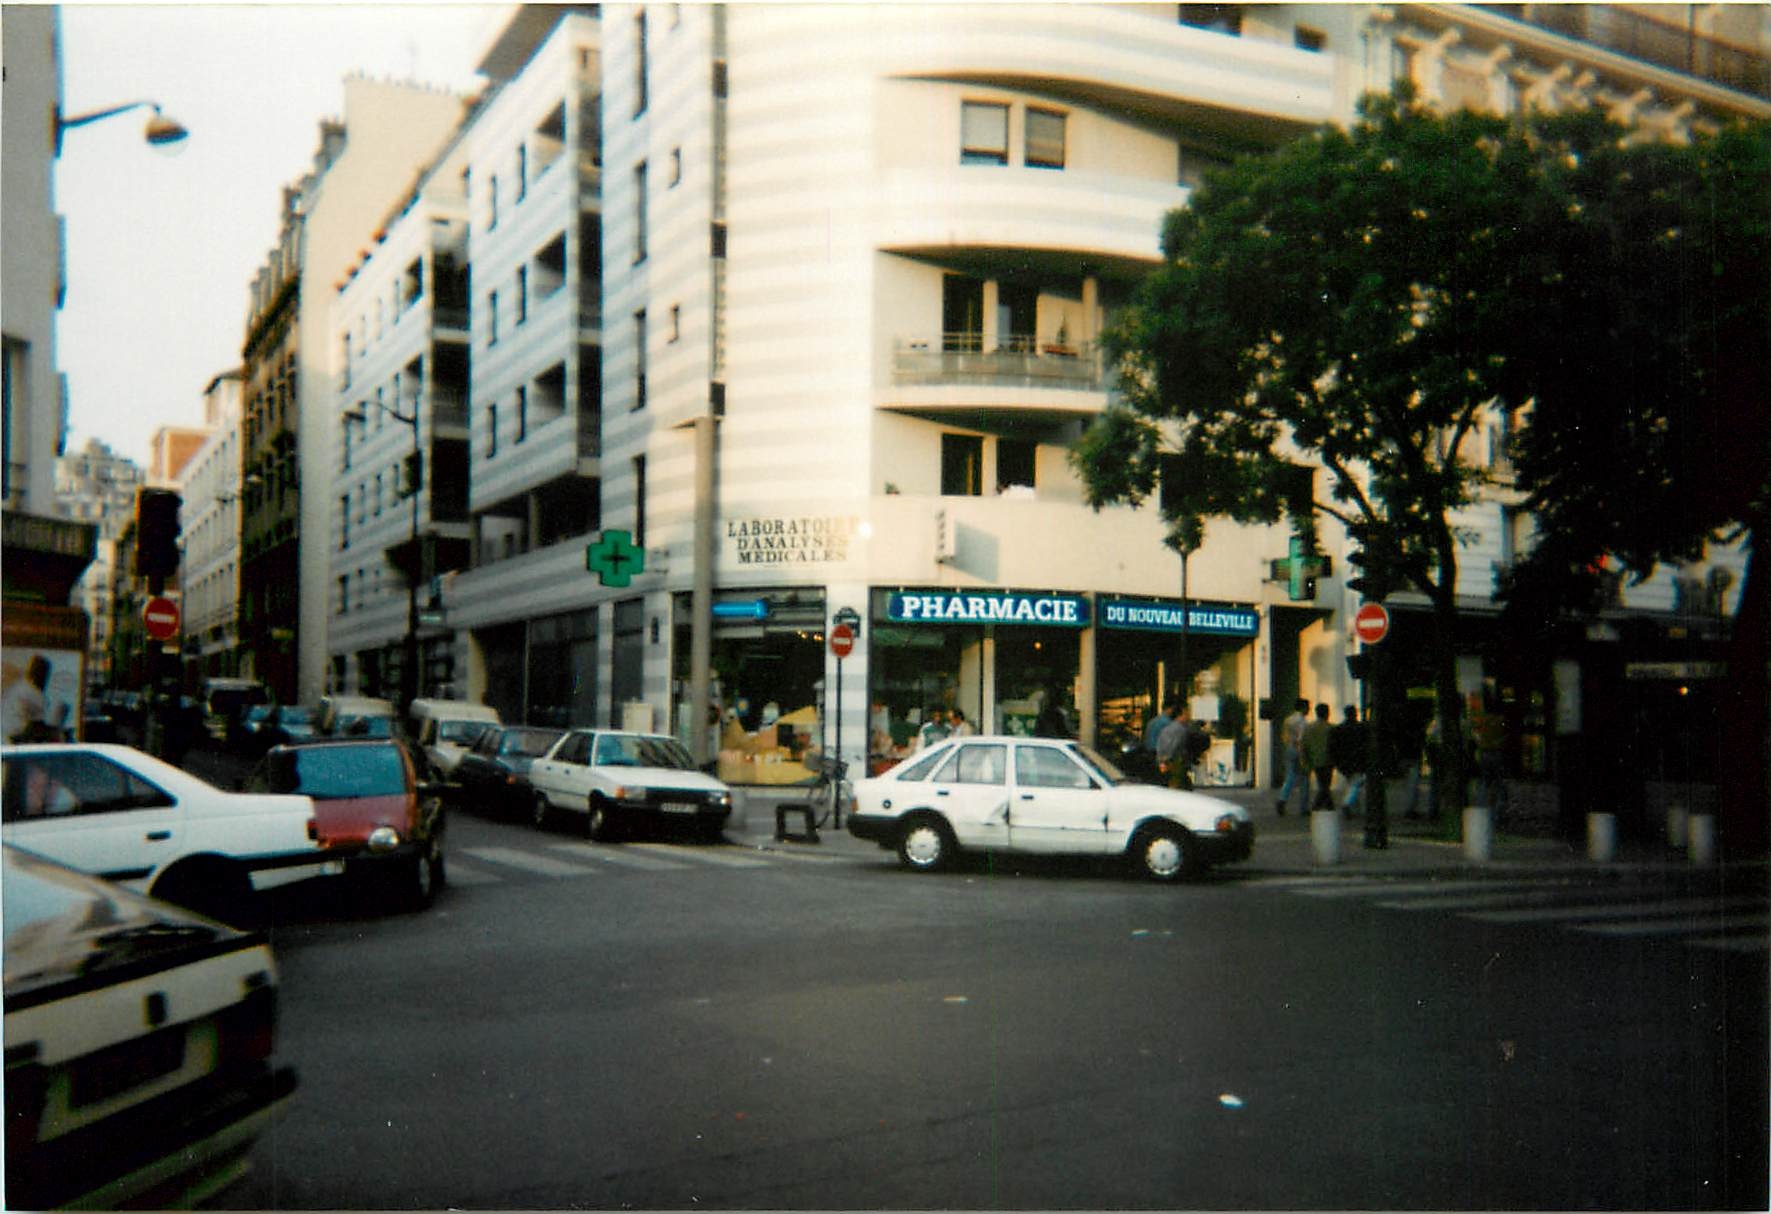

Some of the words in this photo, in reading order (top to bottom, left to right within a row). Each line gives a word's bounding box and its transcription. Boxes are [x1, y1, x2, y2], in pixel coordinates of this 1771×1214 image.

[728, 515, 859, 537] LABORATOI
[738, 549, 848, 563] MEDICALES
[901, 595, 1077, 622] PHARMACIE
[1106, 606, 1125, 622] DU
[1188, 612, 1254, 630] BELLEVILLE
